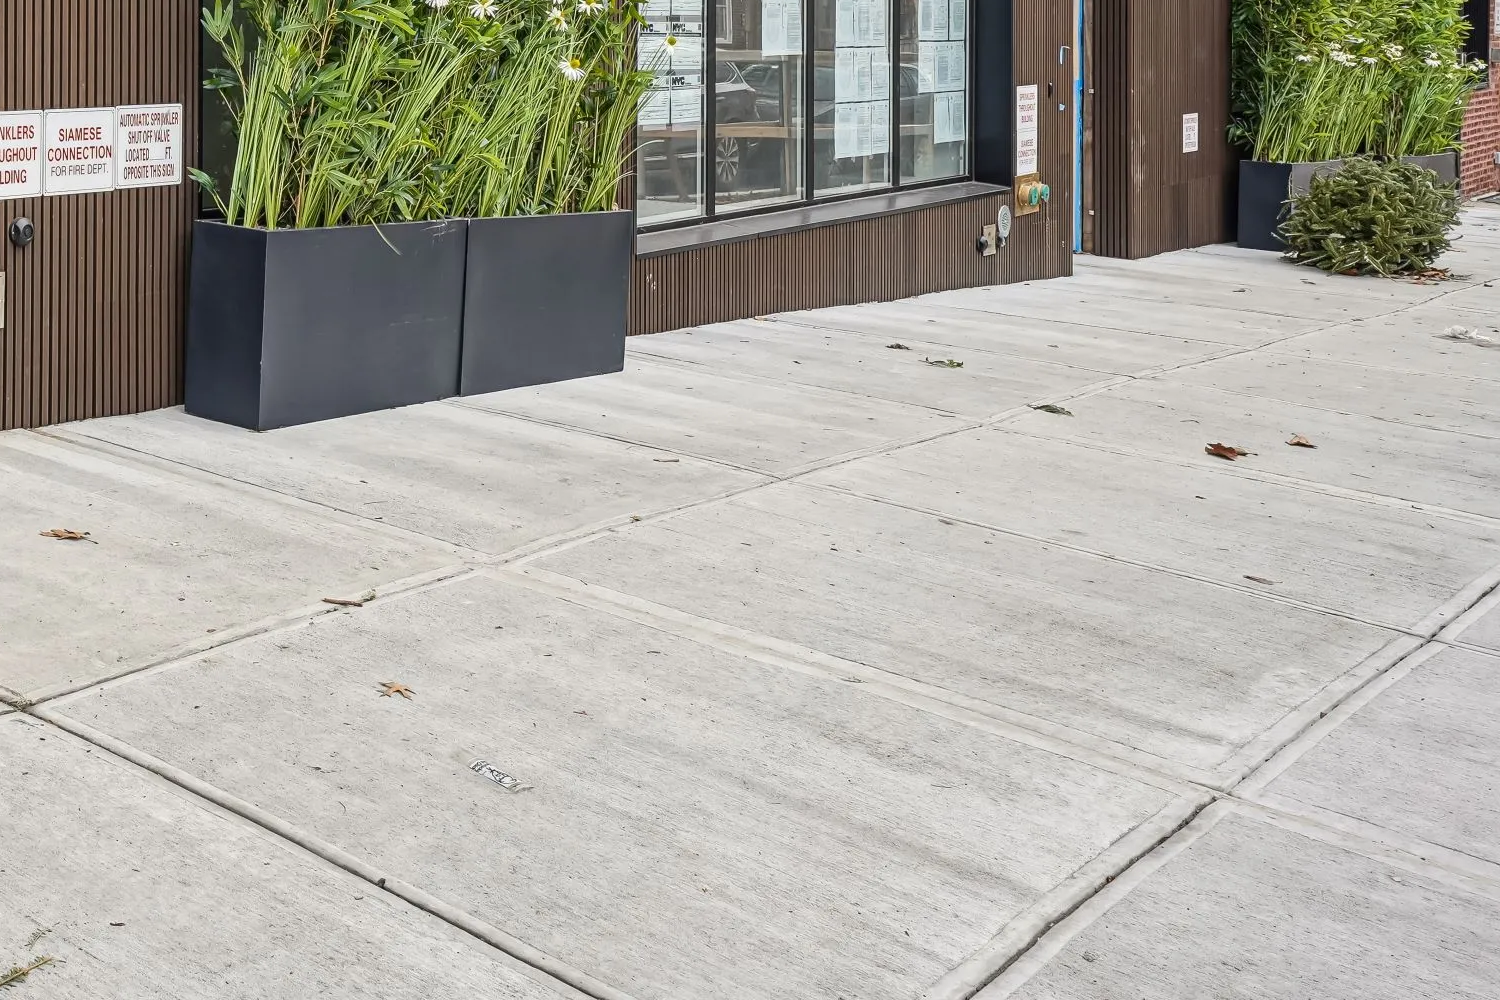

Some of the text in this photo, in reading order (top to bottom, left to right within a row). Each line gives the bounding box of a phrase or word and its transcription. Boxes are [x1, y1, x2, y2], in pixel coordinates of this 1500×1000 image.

[672, 23, 686, 32] NYC
[671, 76, 685, 86] NYC
[120, 112, 179, 128] AUTOMATIC SPRINKLER
[58, 127, 102, 142] SIAMESE
[128, 129, 170, 144] SHUT OFF VALVE
[47, 145, 112, 162] CONNECTION
[125, 146, 173, 162] LOCATED FT.
[51, 163, 109, 177] FOR FIRE DEPT.
[124, 163, 174, 180] OPPOSITE THIS SIGN
